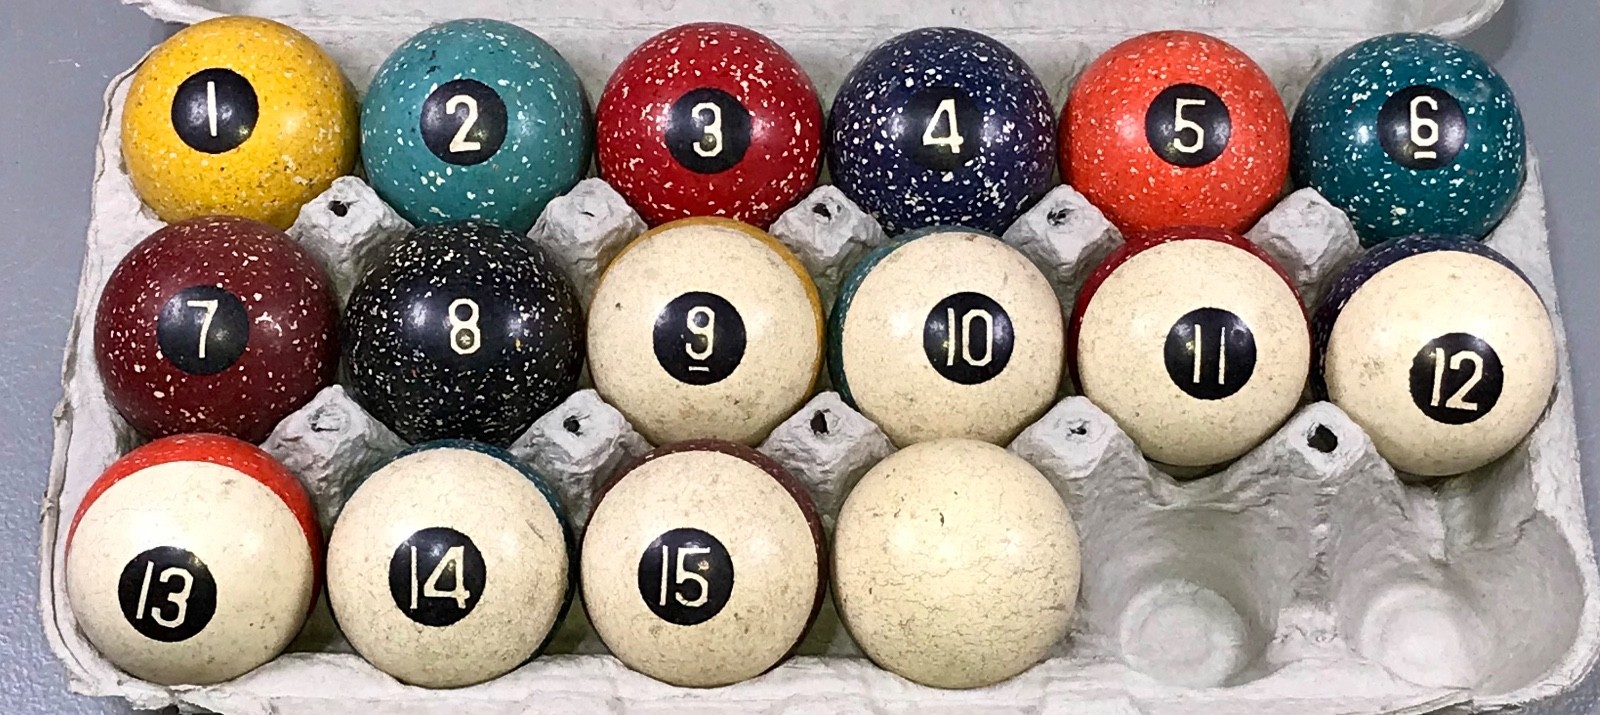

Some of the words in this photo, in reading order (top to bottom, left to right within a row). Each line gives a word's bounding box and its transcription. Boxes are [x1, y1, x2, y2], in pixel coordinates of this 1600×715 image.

[206, 81, 219, 137] 1
[445, 95, 481, 153] 2
[691, 102, 723, 158] 3
[923, 99, 964, 155] 4
[1173, 98, 1206, 154] 5
[1409, 96, 1439, 160] 6
[187, 299, 219, 359] 7
[447, 299, 481, 355] 8
[685, 307, 716, 372] 9
[946, 308, 994, 367] 10
[1192, 324, 1227, 385] 11
[1430, 347, 1484, 411] 12
[135, 561, 194, 629] 13
[409, 544, 472, 610] 14
[659, 544, 711, 607] 15
